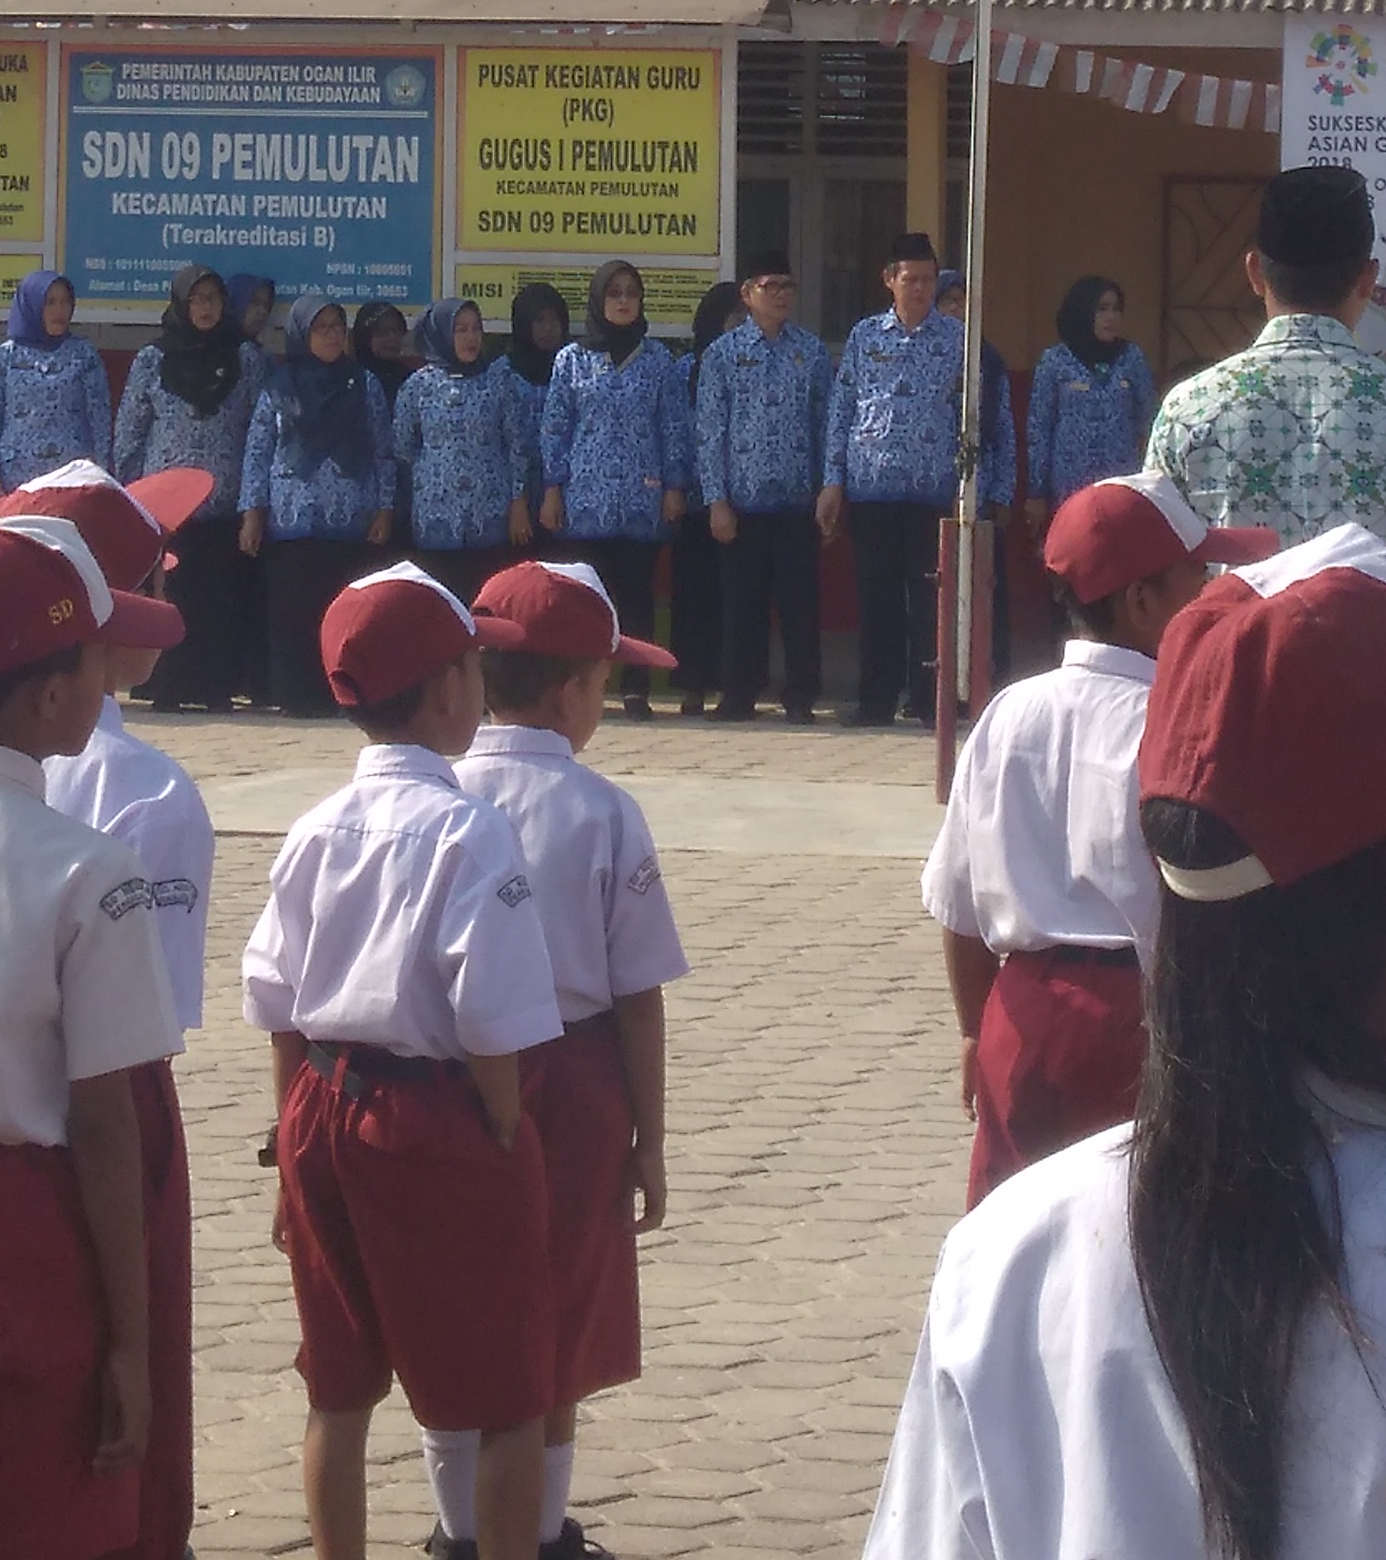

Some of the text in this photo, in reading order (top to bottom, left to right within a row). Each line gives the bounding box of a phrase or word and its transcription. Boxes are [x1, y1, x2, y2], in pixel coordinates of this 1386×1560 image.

[122, 63, 376, 83] PEMERINTAH KABUPATEN OGAN ILIR
[478, 64, 700, 90] PUSAT KEGIATAN GURU
[116, 83, 381, 104] DINAS PENDIDIKAN DAN KEBUDAYAAN
[563, 98, 614, 127] (PKG)
[81, 130, 419, 184] SDN 09 PEMULUTAN
[479, 138, 699, 174] GUGUS I PEMULUTAN
[1307, 136, 1367, 152] ASIAN
[496, 180, 679, 198] KECAMATAN PEMULUTAN
[112, 192, 387, 219] KECAMATAN PEMULUTAN
[478, 210, 697, 237] SDN 09 PEMULUTAN
[162, 223, 335, 252] (Terakreditasi B)
[462, 283, 503, 298] MISI
[48, 598, 74, 625] SD
